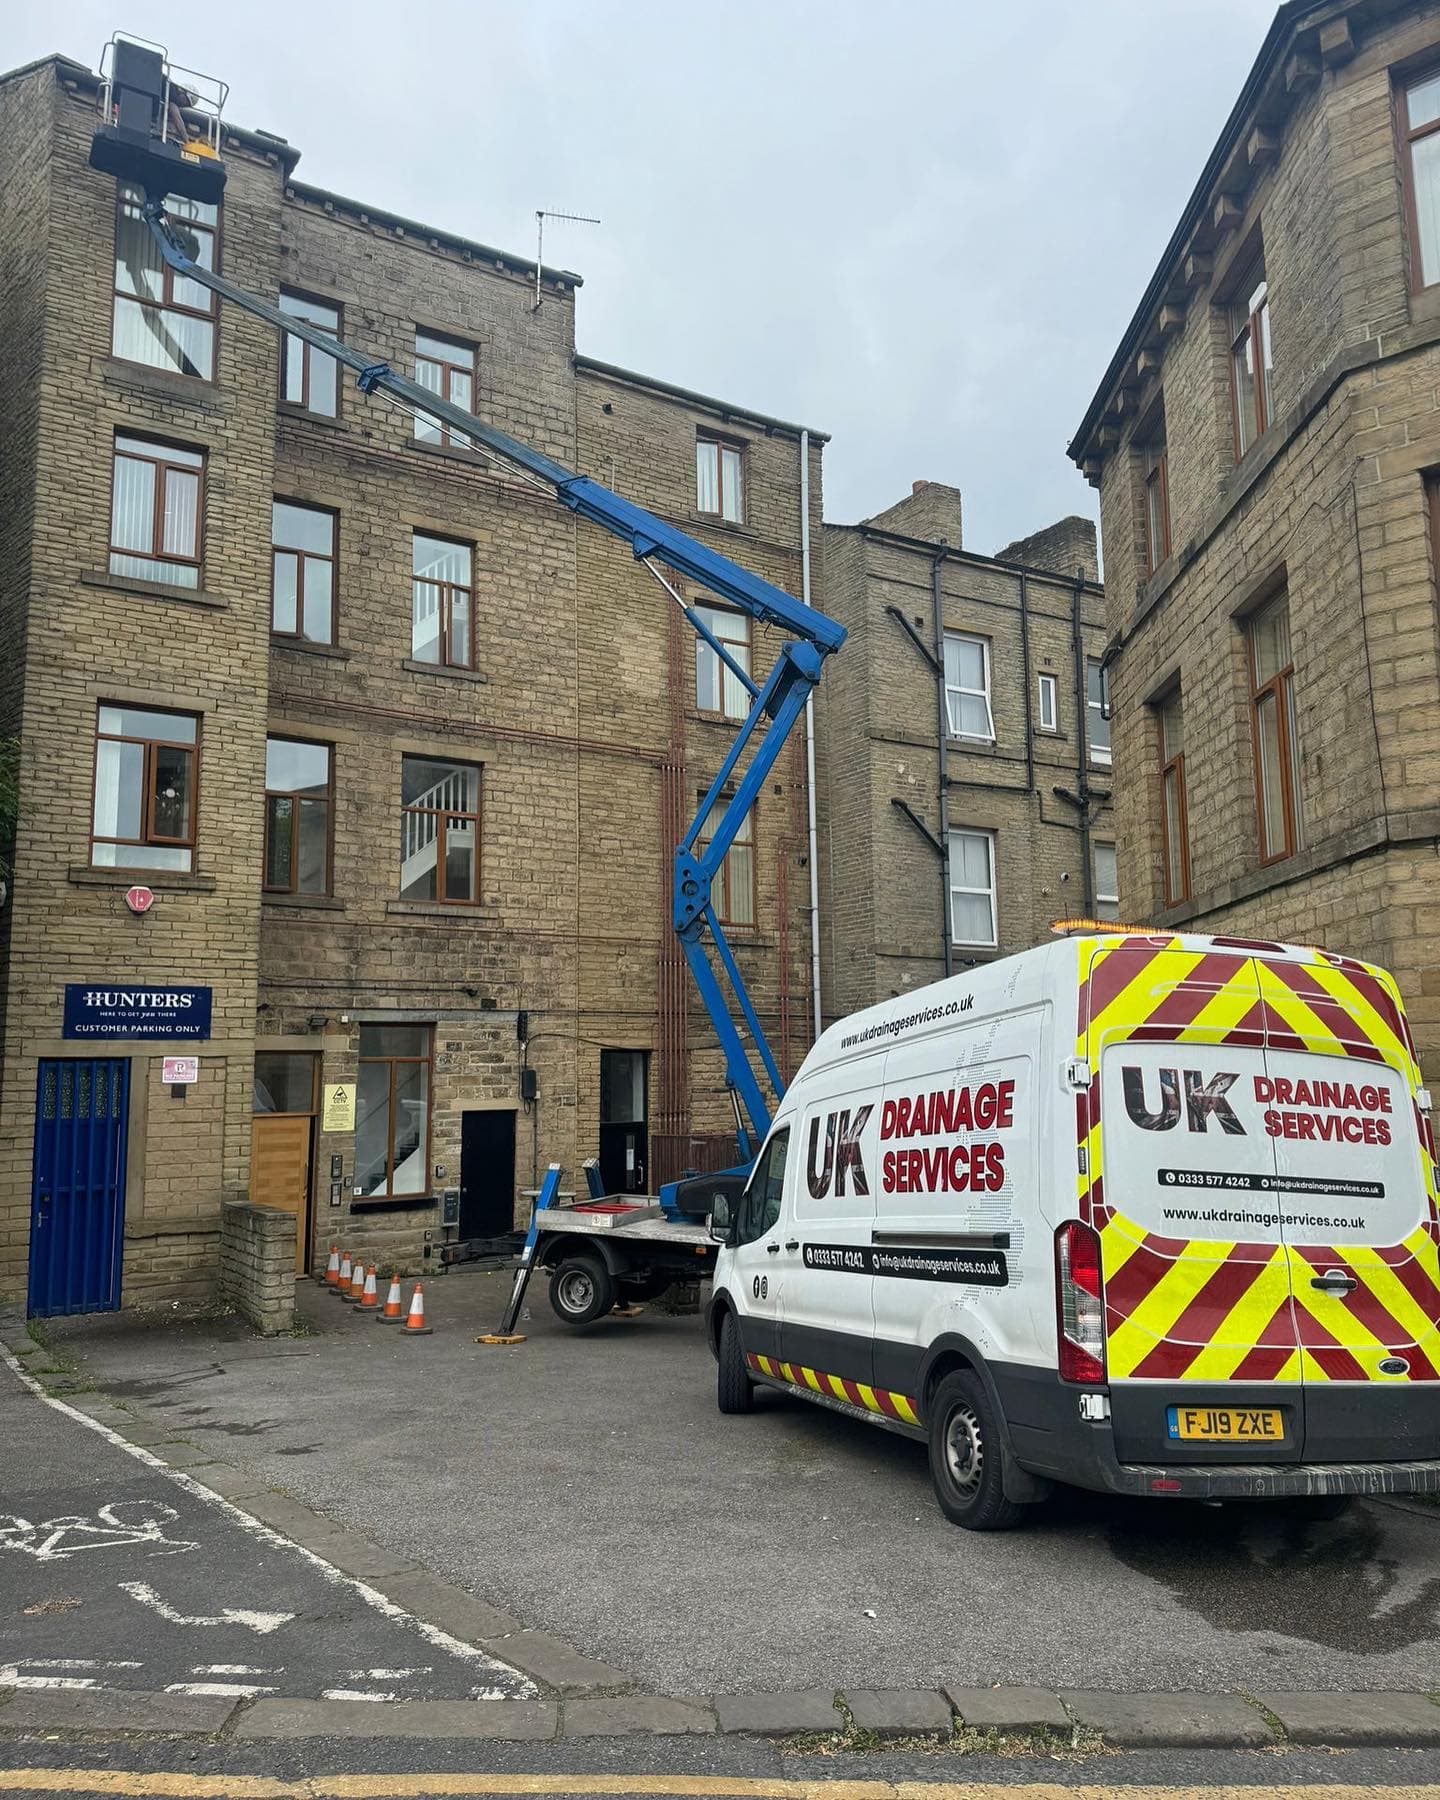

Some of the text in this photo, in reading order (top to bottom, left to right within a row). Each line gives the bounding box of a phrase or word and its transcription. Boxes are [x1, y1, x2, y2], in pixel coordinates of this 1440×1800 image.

[83, 991, 193, 1008] HUNTERS
[75, 1024, 200, 1033] CUSTOMER PARKING ONLY
[840, 993, 974, 1049] www.ukdrainageservices.co.uk
[880, 1079, 1015, 1140] DRAINAGE
[1121, 1066, 1247, 1135] UK
[1253, 1075, 1393, 1114] DRAINAGE
[1264, 1110, 1392, 1146] SERVICES
[806, 1103, 875, 1200] UK
[882, 1142, 1005, 1194] SERVICES
[1178, 1173, 1380, 1195] 0333 577 4242 info@ukdrainageservices.co.uk
[1163, 1208, 1366, 1229] www.ukdrainageservices.co.uk
[813, 1248, 1001, 1275] 0333 577 4242 info@ukdrainageservices.co.uk
[1185, 1412, 1275, 1435] FJ19 ZXE
